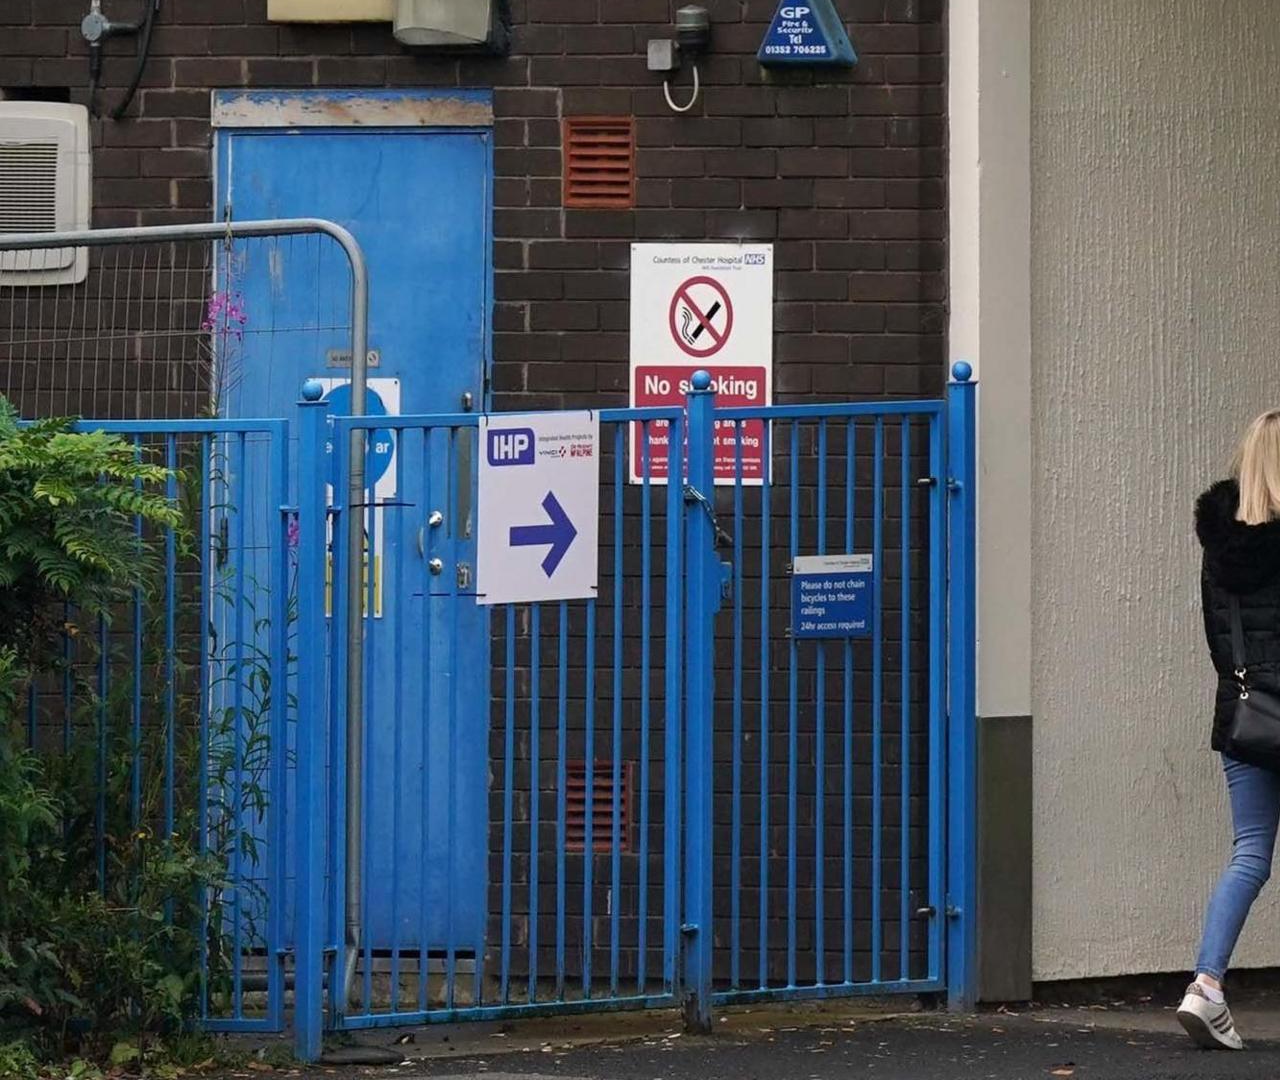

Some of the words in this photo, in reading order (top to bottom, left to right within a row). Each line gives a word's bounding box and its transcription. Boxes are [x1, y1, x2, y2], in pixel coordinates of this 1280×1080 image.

[780, 6, 810, 19] GP
[777, 26, 813, 34] Security
[765, 45, 791, 55] 01352
[653, 256, 681, 265] Countess
[683, 256, 690, 264] of
[691, 255, 715, 265] Chester
[717, 255, 743, 265] Hospital
[745, 254, 765, 265] NHS
[645, 375, 670, 395] No
[649, 436, 669, 445] hank
[723, 435, 759, 447] smking
[493, 434, 529, 461] IHP
[800, 580, 822, 590] Please
[823, 581, 832, 590] do
[834, 581, 845, 589] not
[846, 579, 865, 589] chain
[801, 593, 827, 604] bicycles
[837, 593, 855, 601] these
